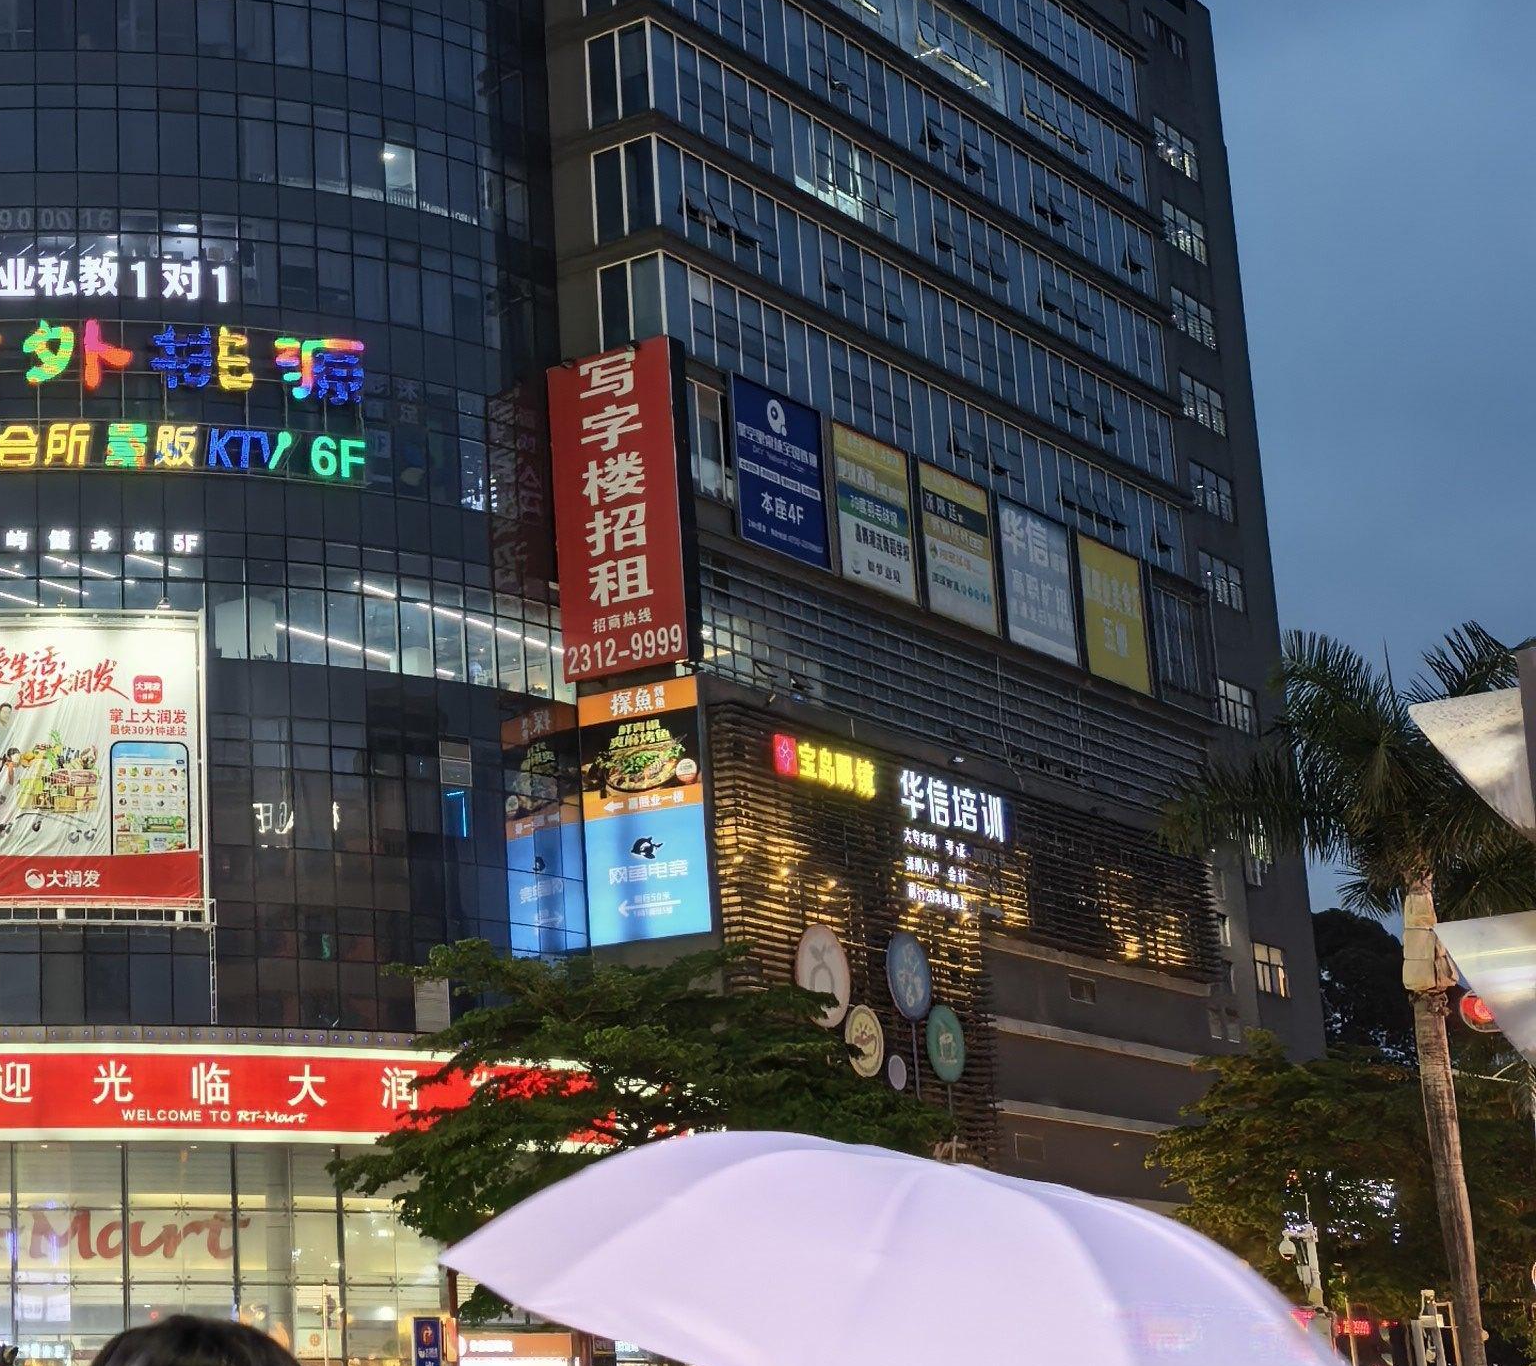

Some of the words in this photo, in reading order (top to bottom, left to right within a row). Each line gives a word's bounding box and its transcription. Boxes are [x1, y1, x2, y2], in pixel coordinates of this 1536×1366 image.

[310, 435, 367, 478] 6F
[579, 349, 654, 608] 写字楼招租
[592, 607, 653, 634] 招商热线
[567, 623, 684, 675] 2312-9999
[109, 708, 188, 725] 掌上大润发
[899, 768, 1006, 843] 华信培训
[46, 869, 101, 888] 大润发
[121, 1109, 202, 1123] WELCOME
[209, 1110, 231, 1122] TO
[237, 1110, 309, 1124] RT-Mart
